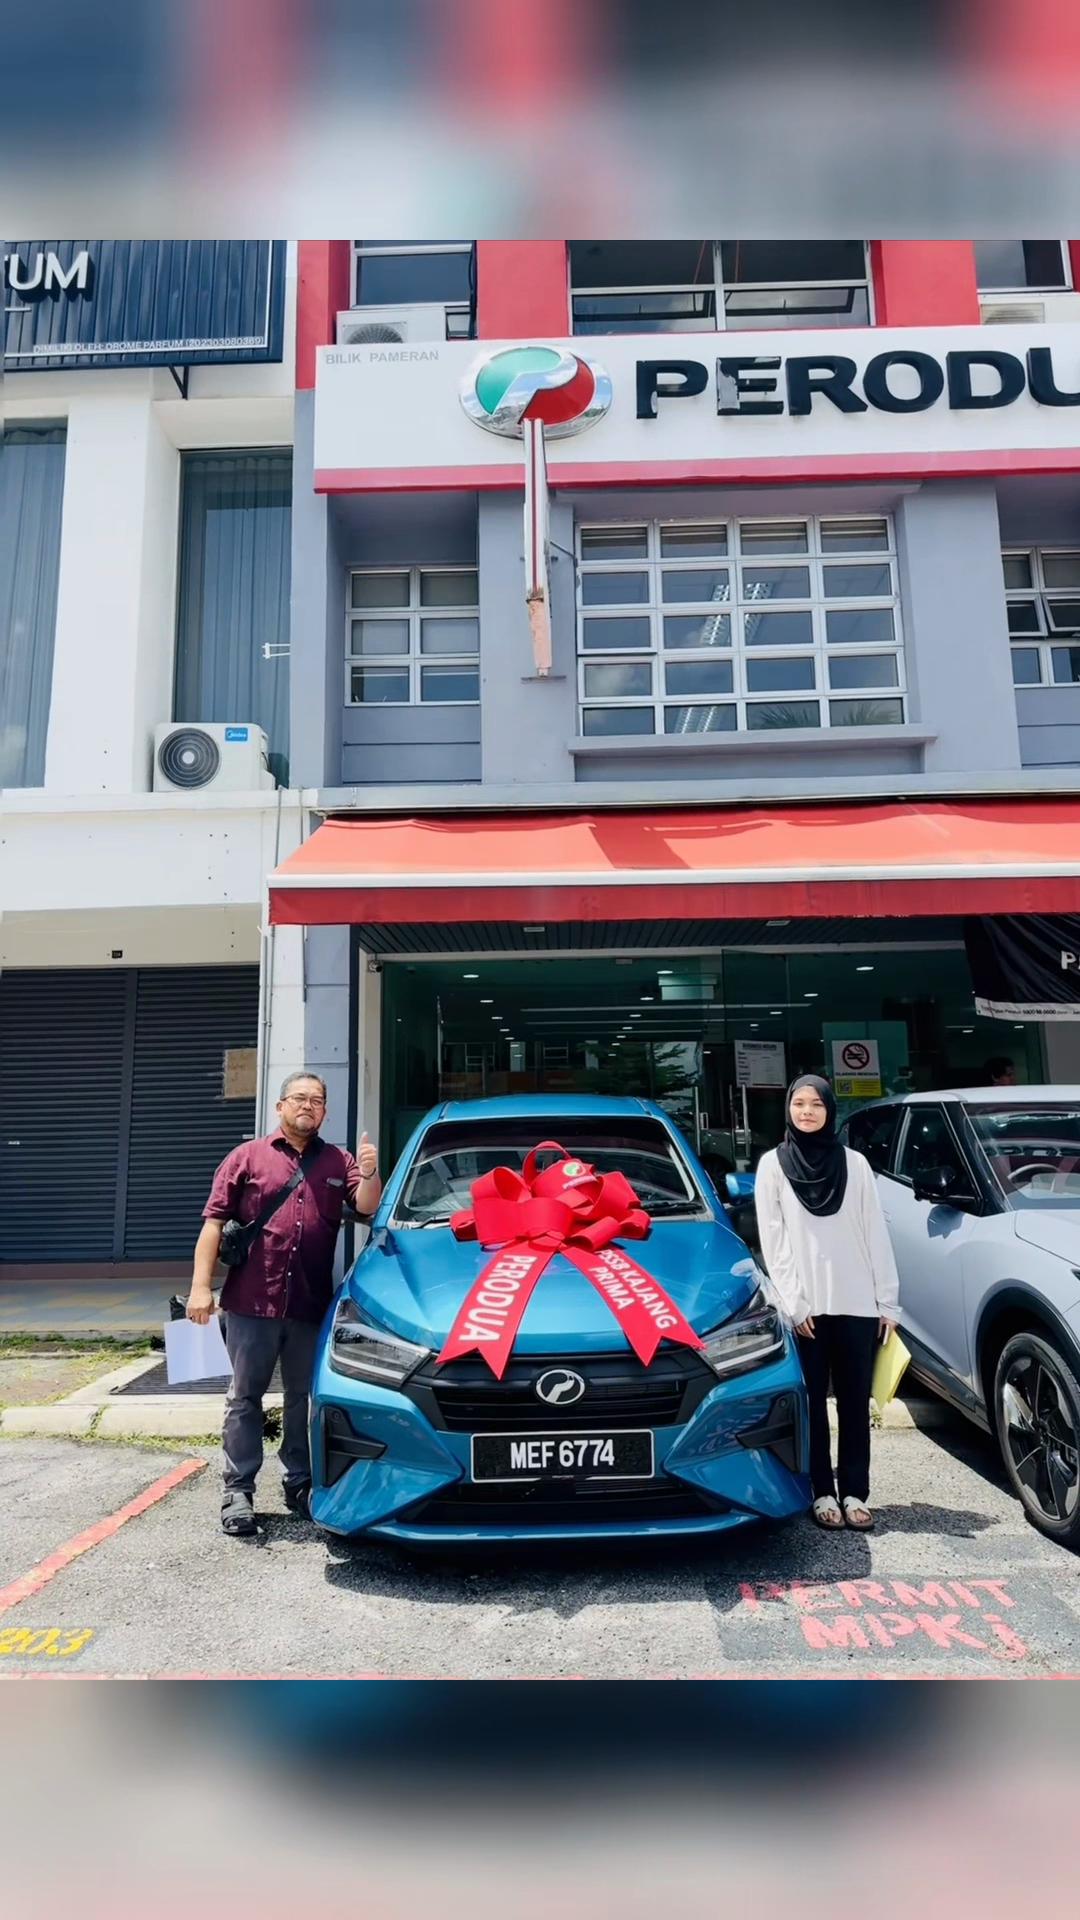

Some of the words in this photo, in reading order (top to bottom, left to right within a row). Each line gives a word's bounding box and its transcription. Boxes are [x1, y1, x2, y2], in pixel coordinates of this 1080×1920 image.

[4, 251, 89, 290] UM
[143, 339, 183, 349] PARFUM
[325, 352, 361, 365] BILIK
[369, 350, 440, 362] PAMERAN
[1061, 950, 1080, 970] P
[458, 1254, 539, 1342] PERODUA
[588, 1266, 636, 1311] PRIMA
[618, 1270, 679, 1330] KAJANG
[510, 1441, 556, 1470] MEF
[558, 1438, 615, 1468] 6774
